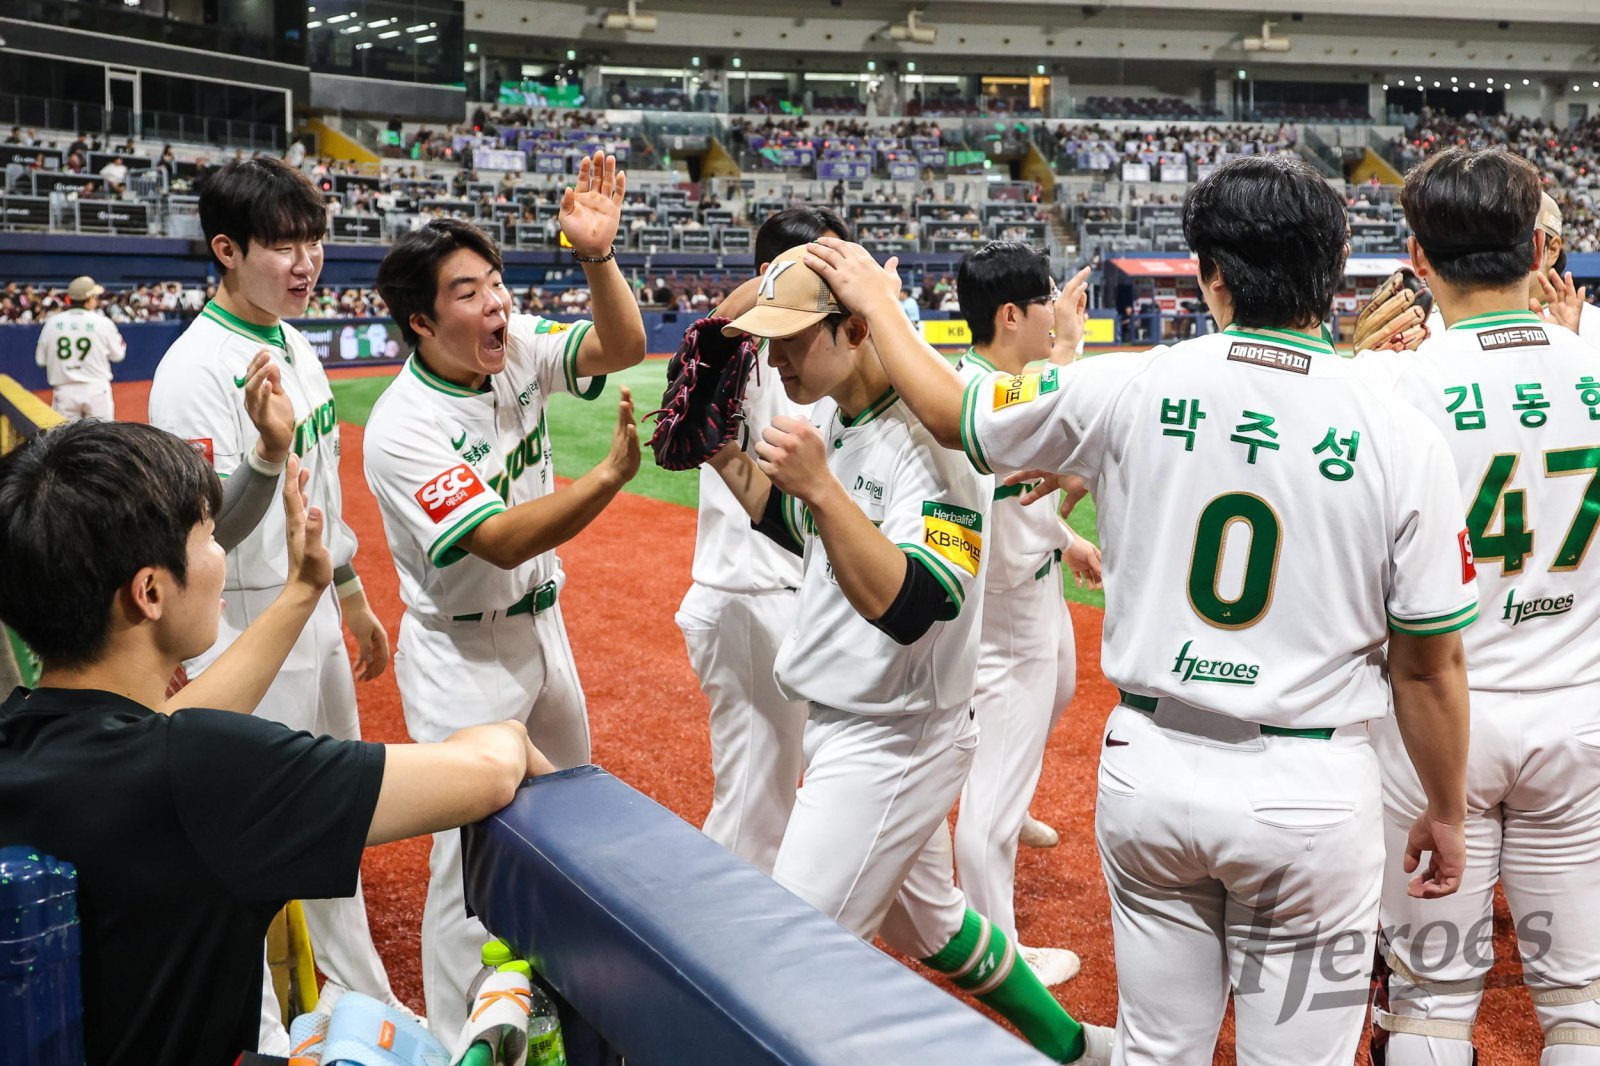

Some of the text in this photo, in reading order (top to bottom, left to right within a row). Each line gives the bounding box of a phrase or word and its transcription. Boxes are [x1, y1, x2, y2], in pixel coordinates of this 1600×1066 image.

[57, 336, 92, 361] 89
[947, 327, 965, 337] KB
[421, 467, 475, 511] SGC
[933, 508, 974, 527] Herbalife
[1464, 444, 1600, 577] 47
[925, 527, 980, 562] KB라이프
[1185, 490, 1284, 632] 0
